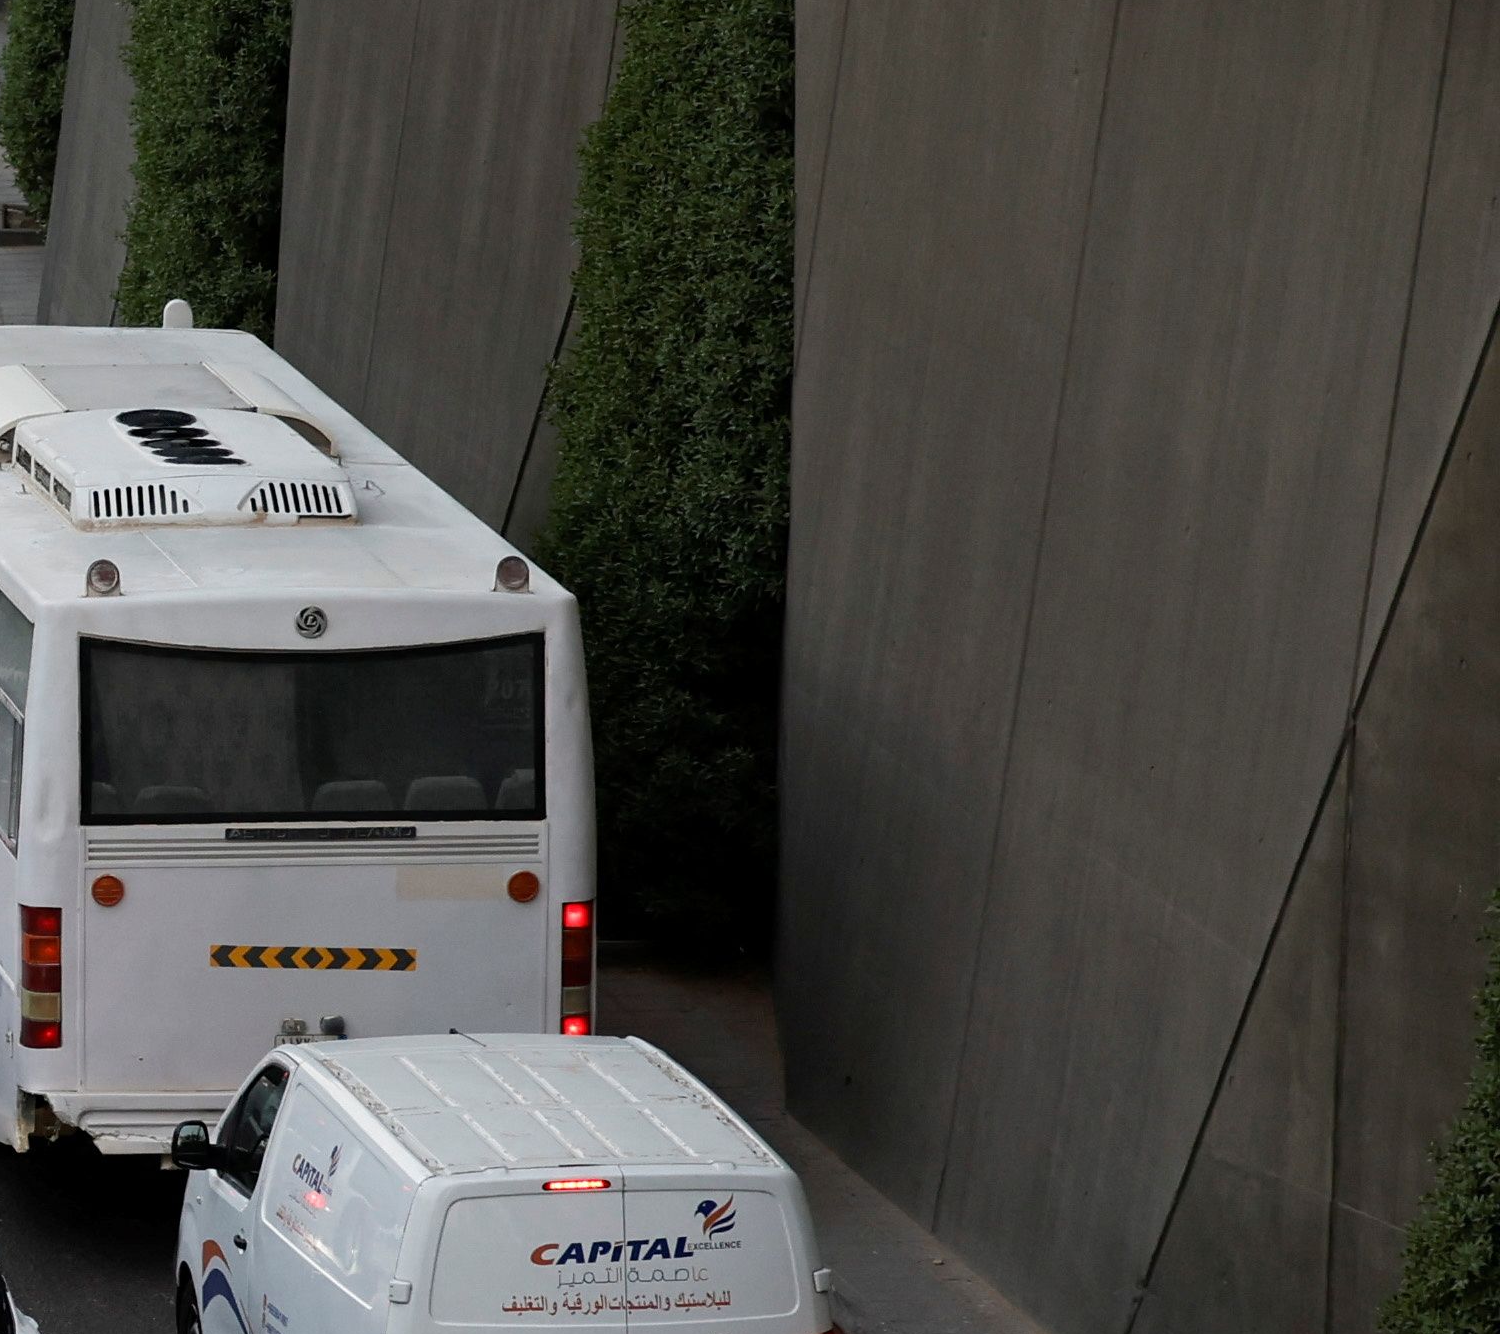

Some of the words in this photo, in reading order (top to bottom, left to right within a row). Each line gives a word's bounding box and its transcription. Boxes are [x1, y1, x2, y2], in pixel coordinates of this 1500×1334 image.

[530, 1236, 694, 1266] CAPITAL
[687, 1240, 742, 1251] EXCELLENCE
[556, 1267, 622, 1289] التميز
[627, 1267, 710, 1283] عاصمة
[501, 1294, 559, 1316] والتغليف
[674, 1290, 732, 1313] للبلاستيك
